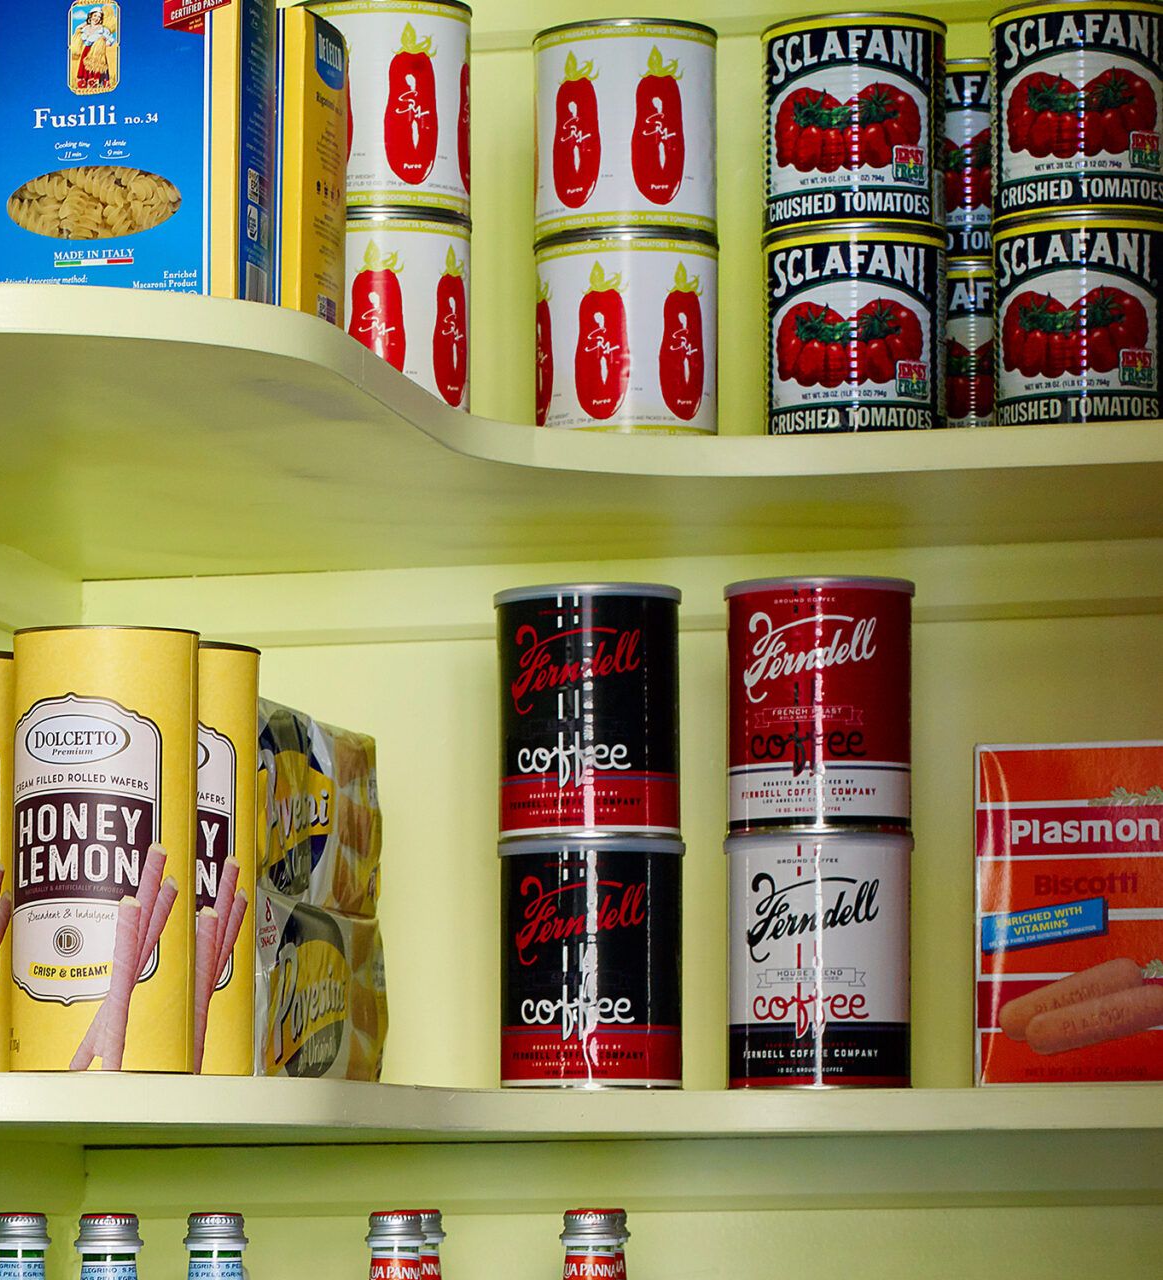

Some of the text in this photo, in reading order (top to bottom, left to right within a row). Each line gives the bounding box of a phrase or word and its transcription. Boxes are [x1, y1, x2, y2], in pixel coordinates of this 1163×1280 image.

[772, 29, 925, 84] SCLAFANI
[33, 105, 117, 129] Fusilli
[403, 162, 422, 170] Puree
[768, 191, 930, 222] CRUSHED TOMATOES
[54, 248, 134, 260] MADE IN ITALY
[999, 232, 1153, 288] SCLAFANI
[132, 279, 197, 289] Macaroni Product
[163, 270, 197, 278] Enriched
[773, 245, 926, 298] SCLAFANI
[771, 405, 932, 435] CRUSHED TOMATOES
[997, 398, 1159, 427] CRUSHED TOMATOES
[511, 624, 640, 716] Ferndell
[743, 611, 877, 703] Ferndell
[772, 708, 808, 716] FRENCH
[34, 730, 118, 749] DOLCETTO
[517, 743, 632, 788] coffee
[19, 802, 142, 848] HONEY
[1009, 817, 1160, 845] Plasmon
[18, 844, 139, 889] LEMON
[1034, 872, 1138, 896] Biscotti
[515, 876, 646, 966] Ferndell
[747, 872, 879, 963] Ferndell
[996, 906, 1083, 928] ENRICHED WITH
[1014, 918, 1068, 935] VITAMINS
[261, 934, 277, 948] SNACK
[33, 965, 108, 978] CRISP & CREAMY
[743, 1049, 878, 1059] FERNDELL COFFE COMPANY
